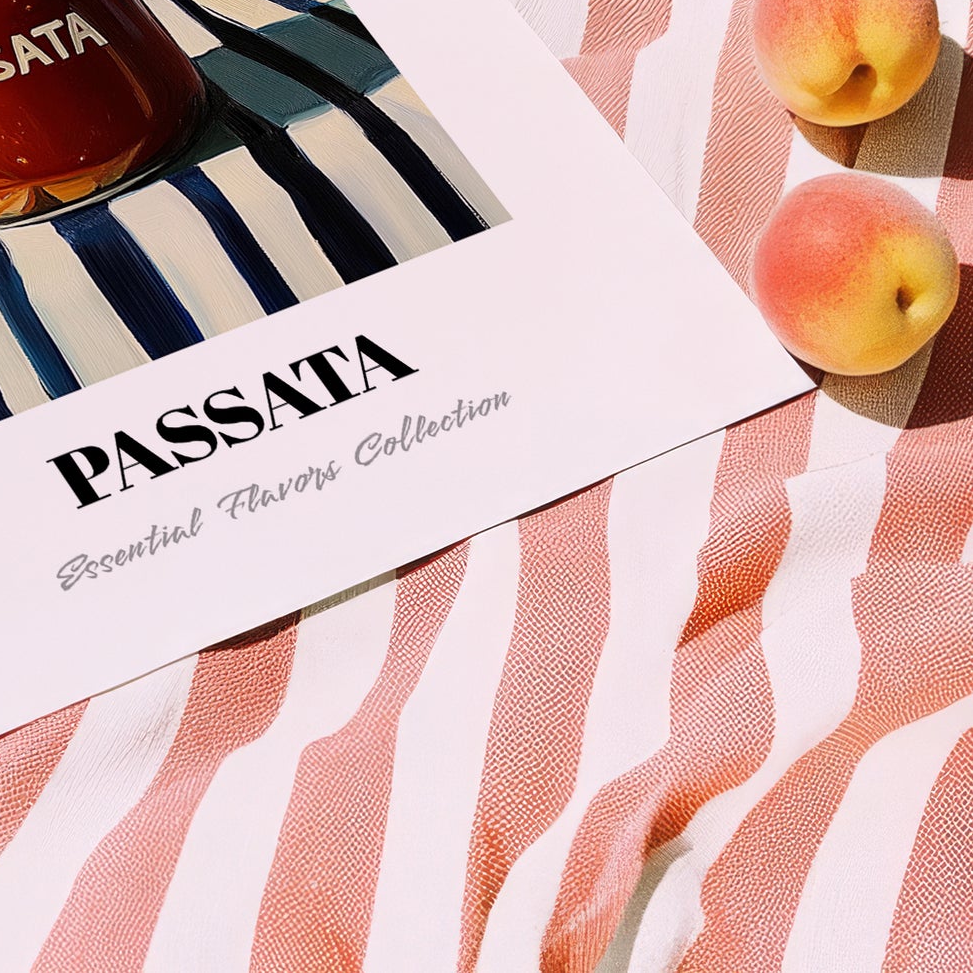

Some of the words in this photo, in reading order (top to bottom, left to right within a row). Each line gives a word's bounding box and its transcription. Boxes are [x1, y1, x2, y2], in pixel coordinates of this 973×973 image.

[46, 334, 420, 509] PASSATA
[56, 507, 204, 591] Essential
[216, 459, 342, 520] Flavors
[354, 390, 512, 466] Collection
